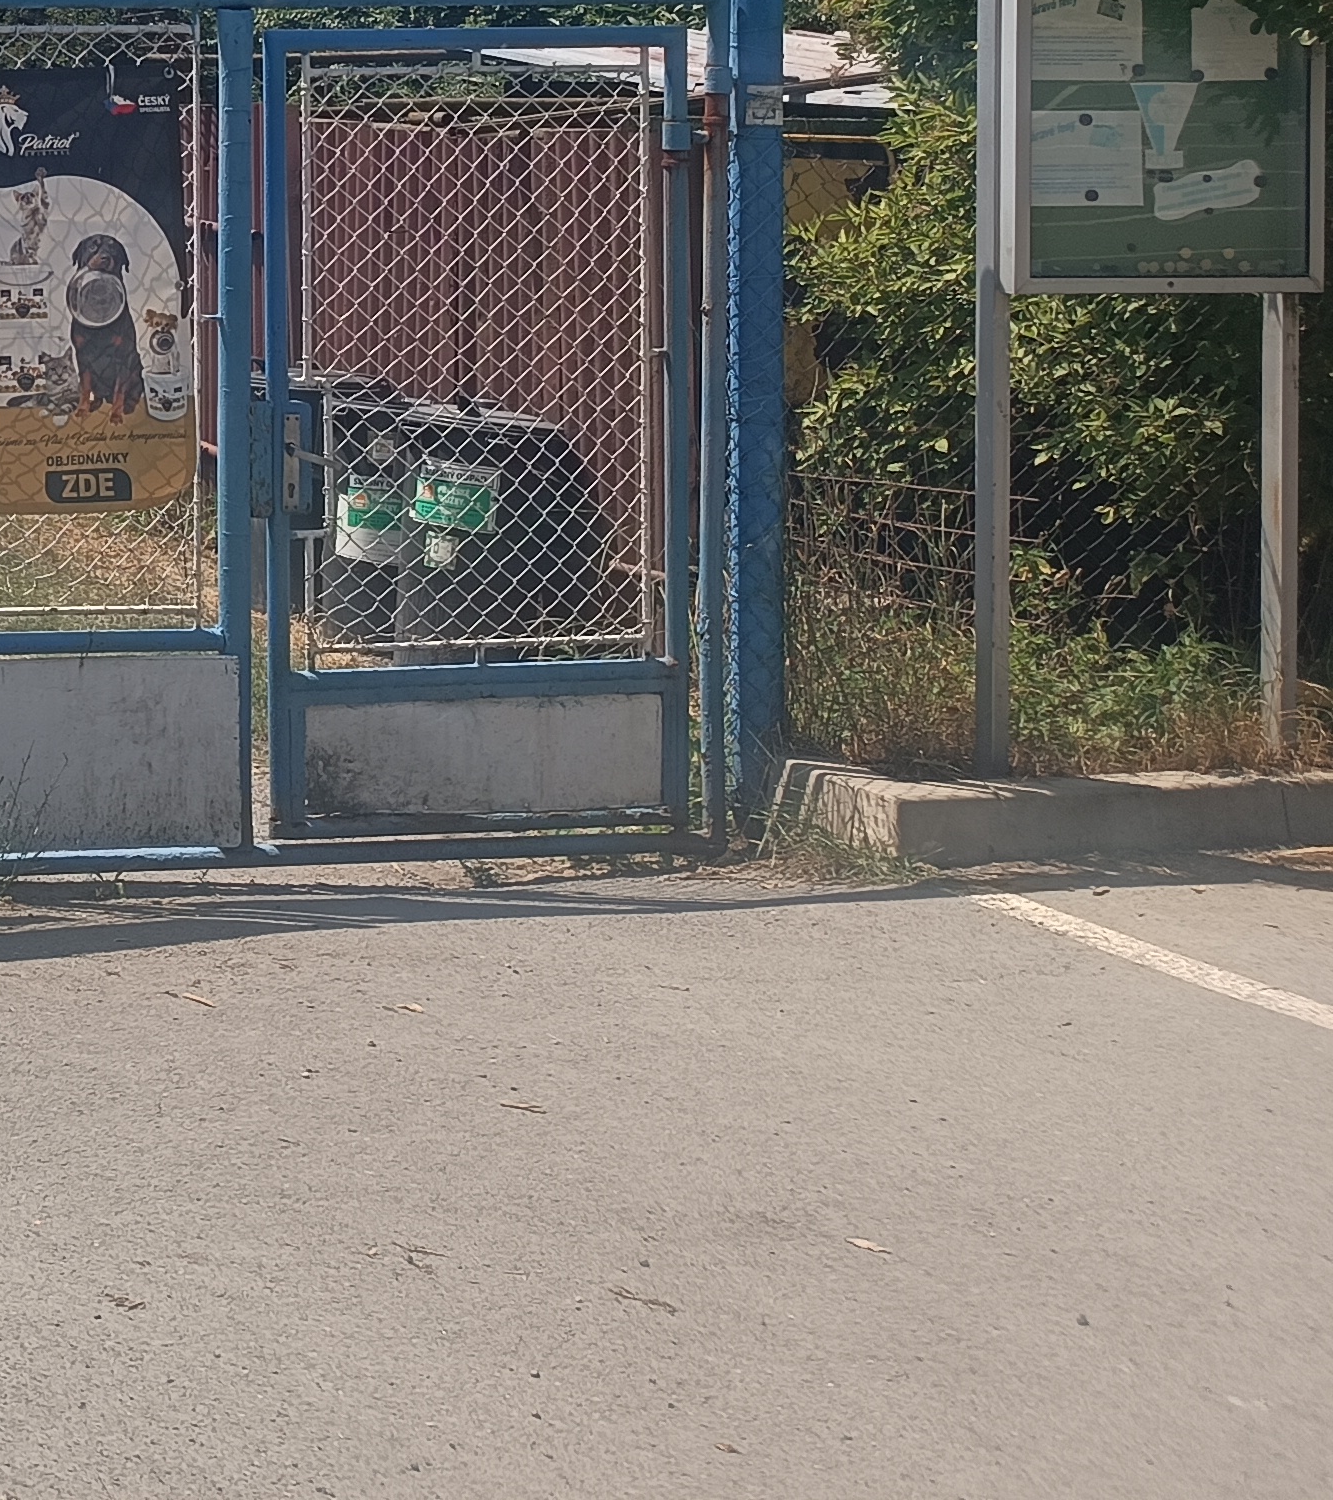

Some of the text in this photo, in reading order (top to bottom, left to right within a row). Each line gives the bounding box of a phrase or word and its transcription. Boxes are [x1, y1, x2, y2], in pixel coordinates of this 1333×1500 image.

[137, 93, 171, 106] ČESKÝ
[18, 132, 75, 156] Patriot
[109, 430, 126, 441] bez
[46, 451, 130, 467] OBJEDNÁVKY
[61, 473, 116, 498] ZDE
